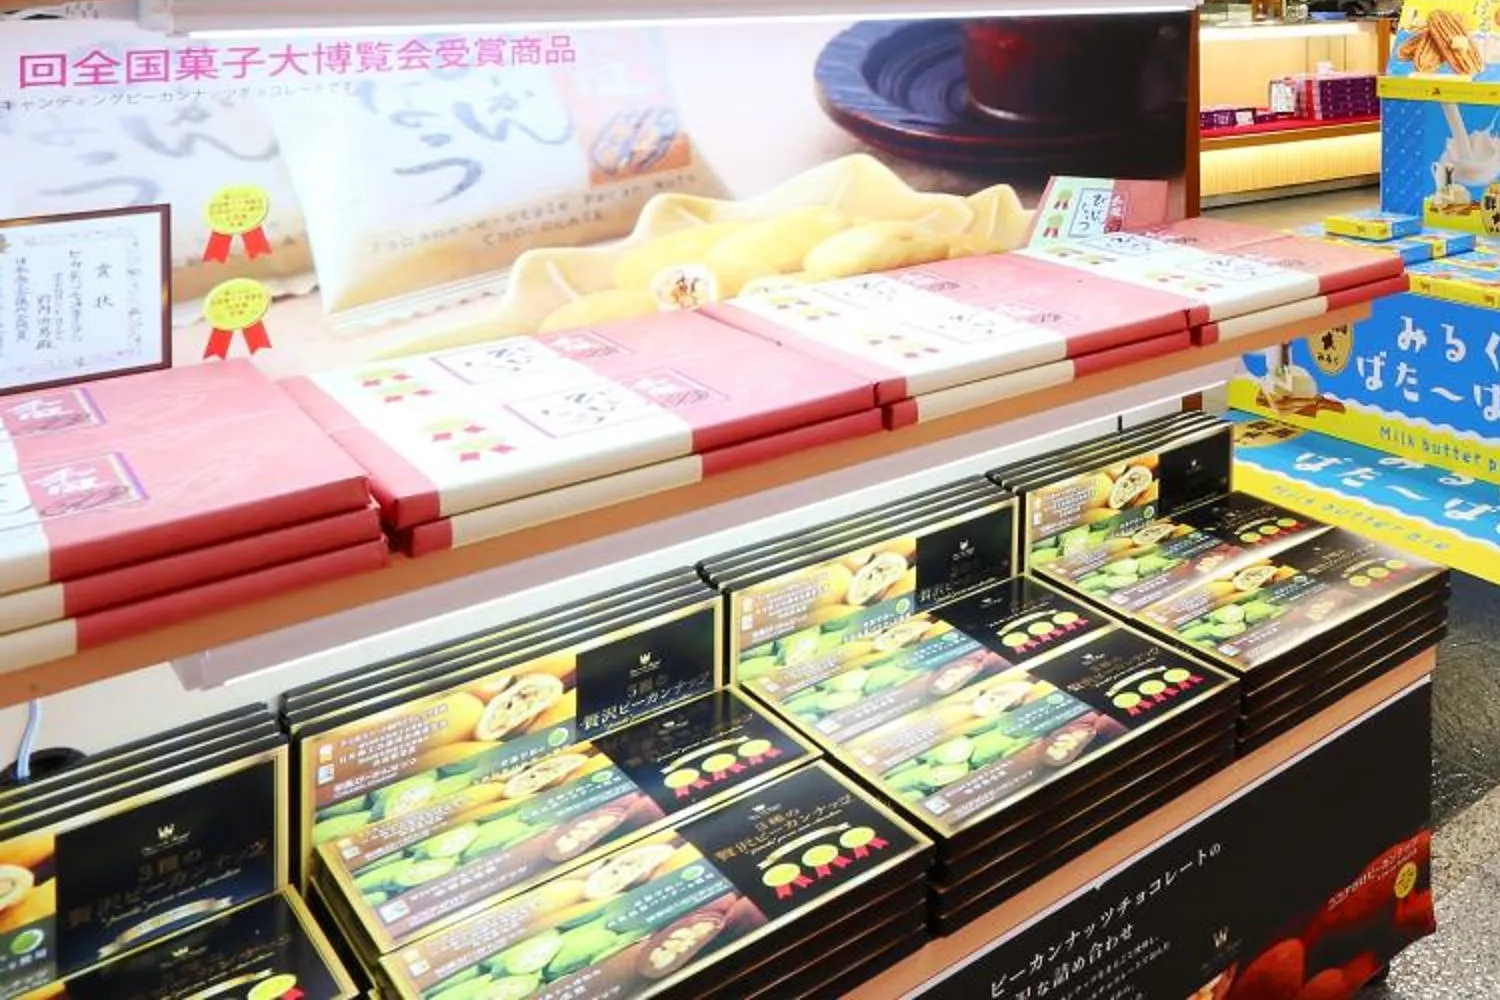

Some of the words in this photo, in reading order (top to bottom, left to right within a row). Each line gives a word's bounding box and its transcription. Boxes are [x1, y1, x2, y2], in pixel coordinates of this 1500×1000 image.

[18, 34, 577, 90] 回全国菓子大博覧会受賞商品
[1379, 426, 1416, 449] Milk
[1421, 439, 1481, 465] butter
[1319, 502, 1407, 538] butter
[990, 842, 1222, 999] ピーカンナッツチョコレートの
